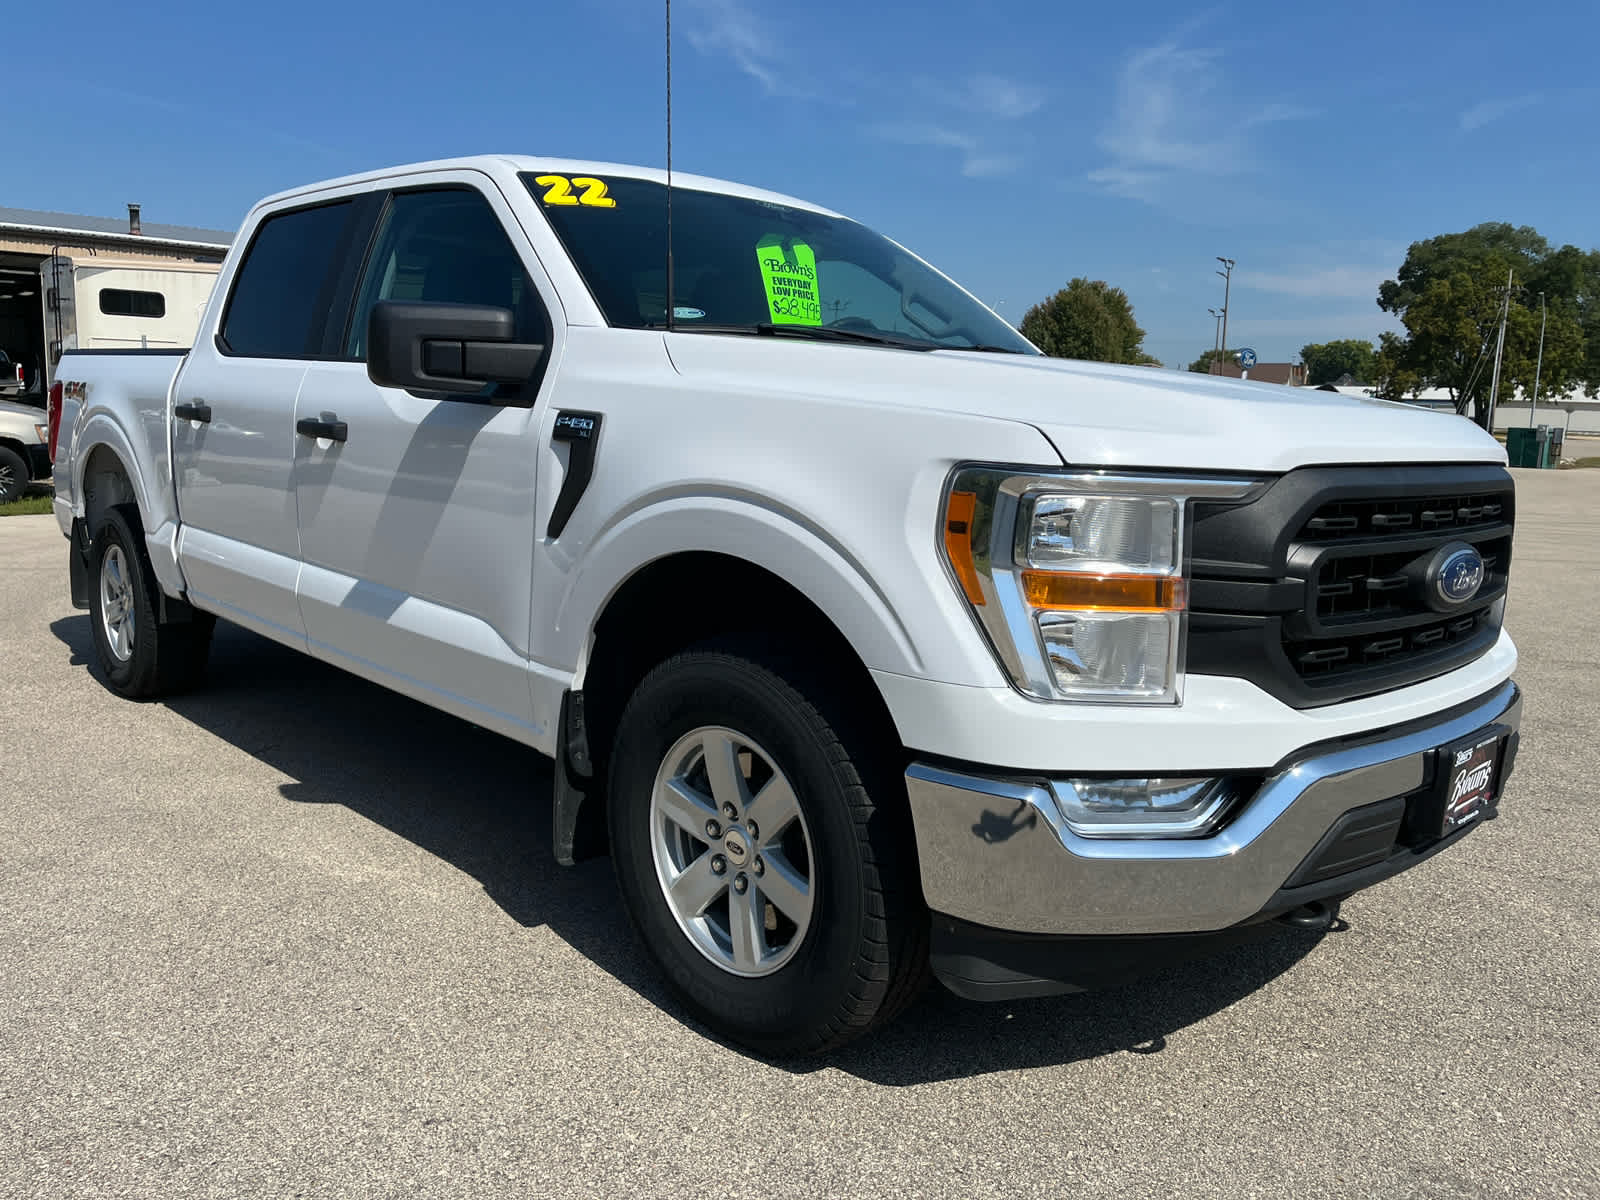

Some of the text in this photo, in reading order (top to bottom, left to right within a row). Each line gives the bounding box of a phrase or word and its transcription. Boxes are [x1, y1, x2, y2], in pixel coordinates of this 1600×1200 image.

[534, 175, 616, 208] 22
[763, 258, 815, 280] Brown's
[772, 276, 812, 290] EVERYDAY
[772, 286, 815, 301] LOW PRICE
[556, 416, 594, 430] F-150
[1452, 562, 1479, 592] Ford
